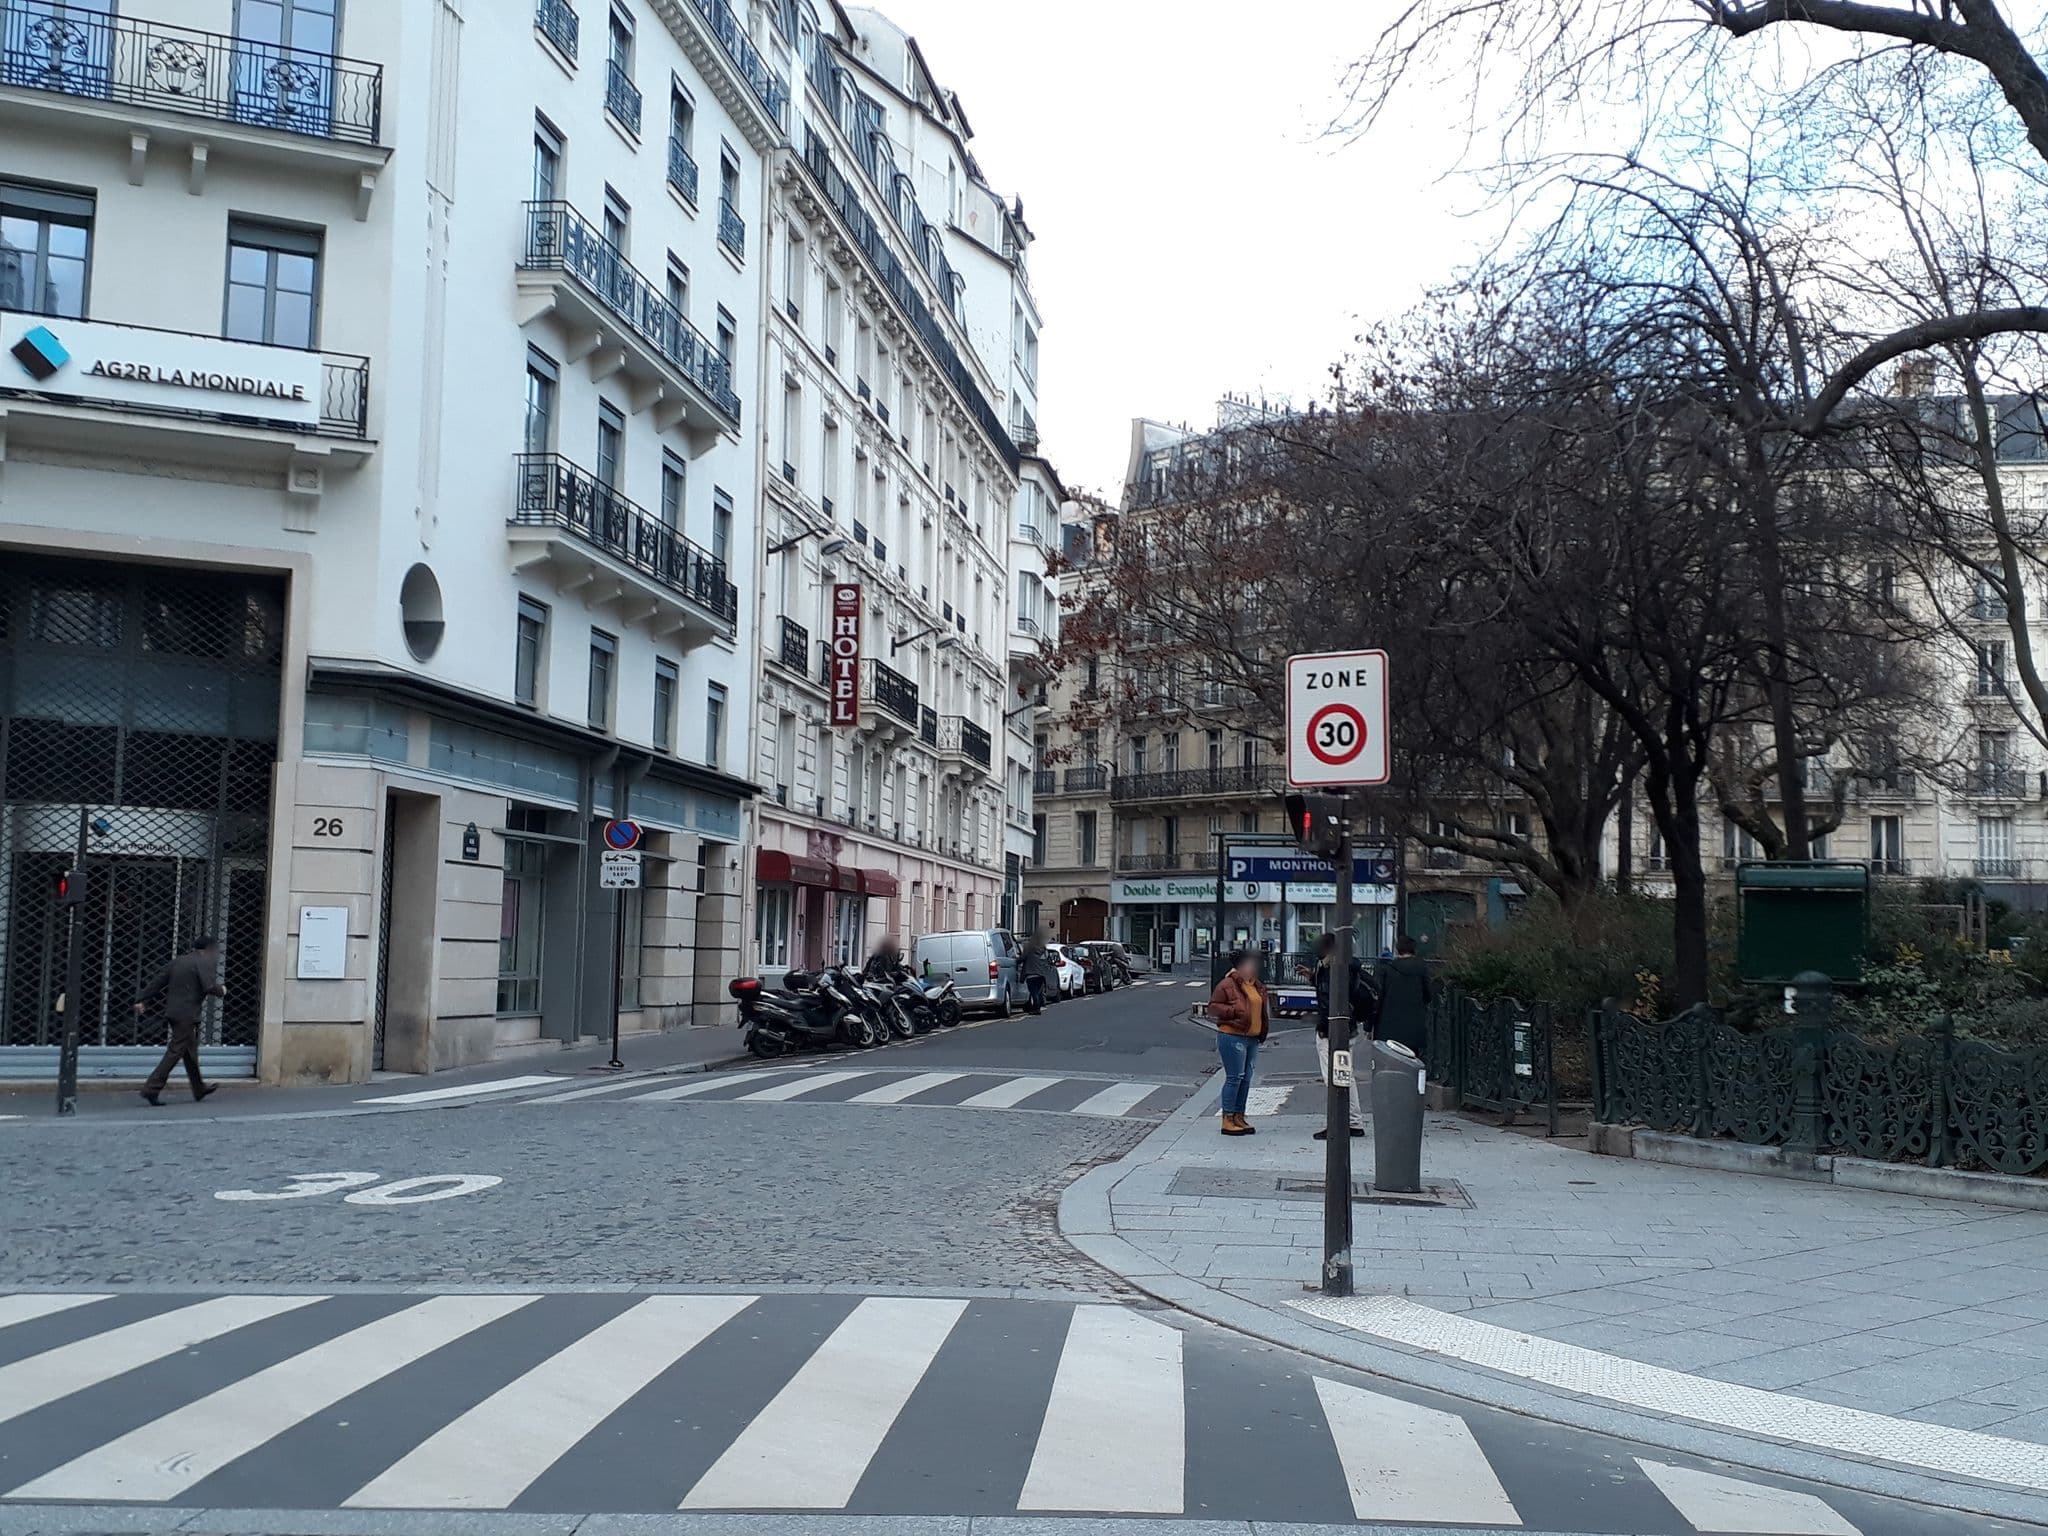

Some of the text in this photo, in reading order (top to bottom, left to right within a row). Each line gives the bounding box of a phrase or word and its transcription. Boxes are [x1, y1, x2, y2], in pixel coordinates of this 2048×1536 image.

[90, 359, 304, 400] AG2R LA MONDIALE
[833, 616, 858, 720] HOTEL
[1306, 669, 1368, 690] ZONE
[1319, 721, 1355, 748] 30
[313, 817, 344, 837] 26
[1232, 859, 1335, 879] P MONTHOL
[1123, 884, 1161, 896] Double
[1279, 996, 1286, 1006] P
[213, 1171, 503, 1205] 30
